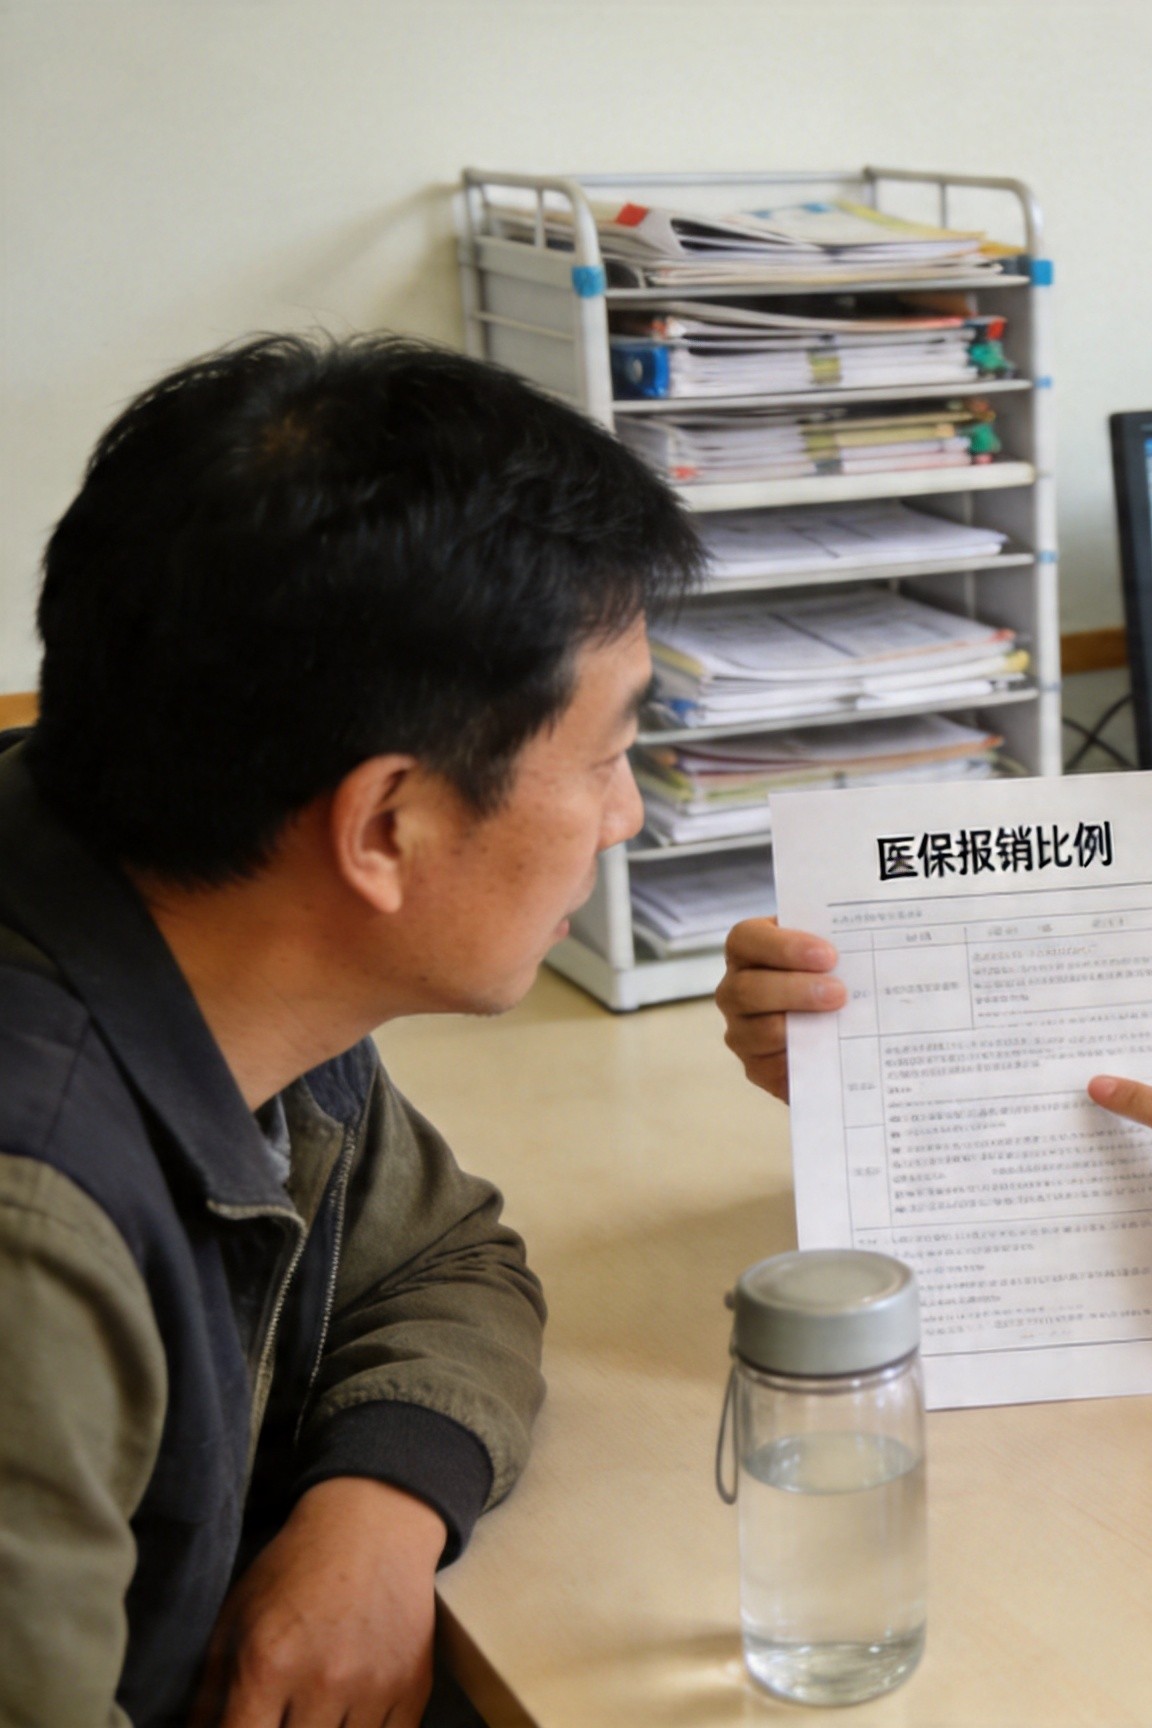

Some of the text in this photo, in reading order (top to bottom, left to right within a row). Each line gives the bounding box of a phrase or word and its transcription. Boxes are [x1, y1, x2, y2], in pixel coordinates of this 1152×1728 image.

[877, 821, 1113, 881] 医保报销比例
